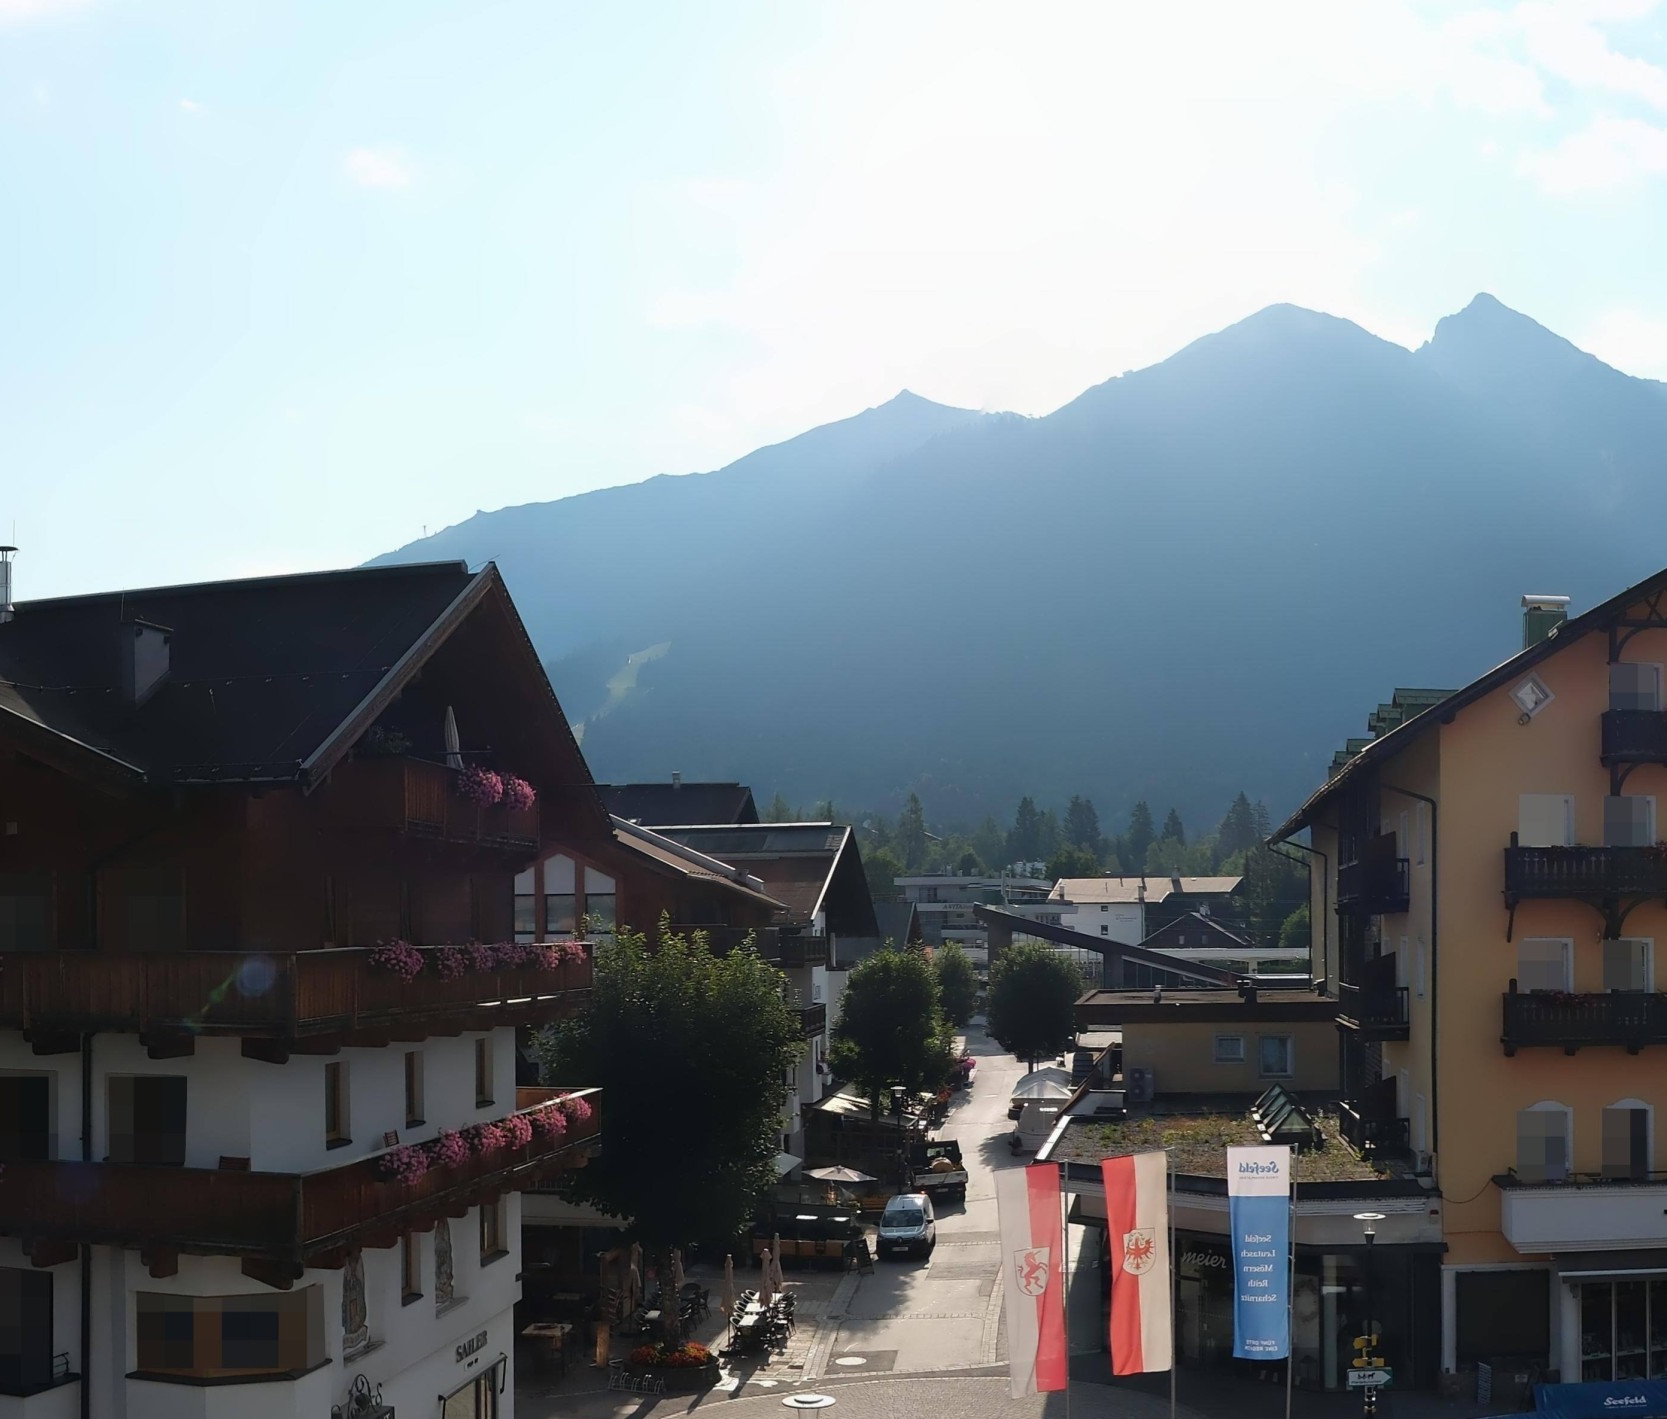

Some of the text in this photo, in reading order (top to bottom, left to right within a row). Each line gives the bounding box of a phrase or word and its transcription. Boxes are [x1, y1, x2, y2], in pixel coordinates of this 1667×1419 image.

[1181, 1250, 1227, 1269] meier
[456, 1330, 488, 1363] SAILER
[1604, 1395, 1647, 1407] Seefeld
